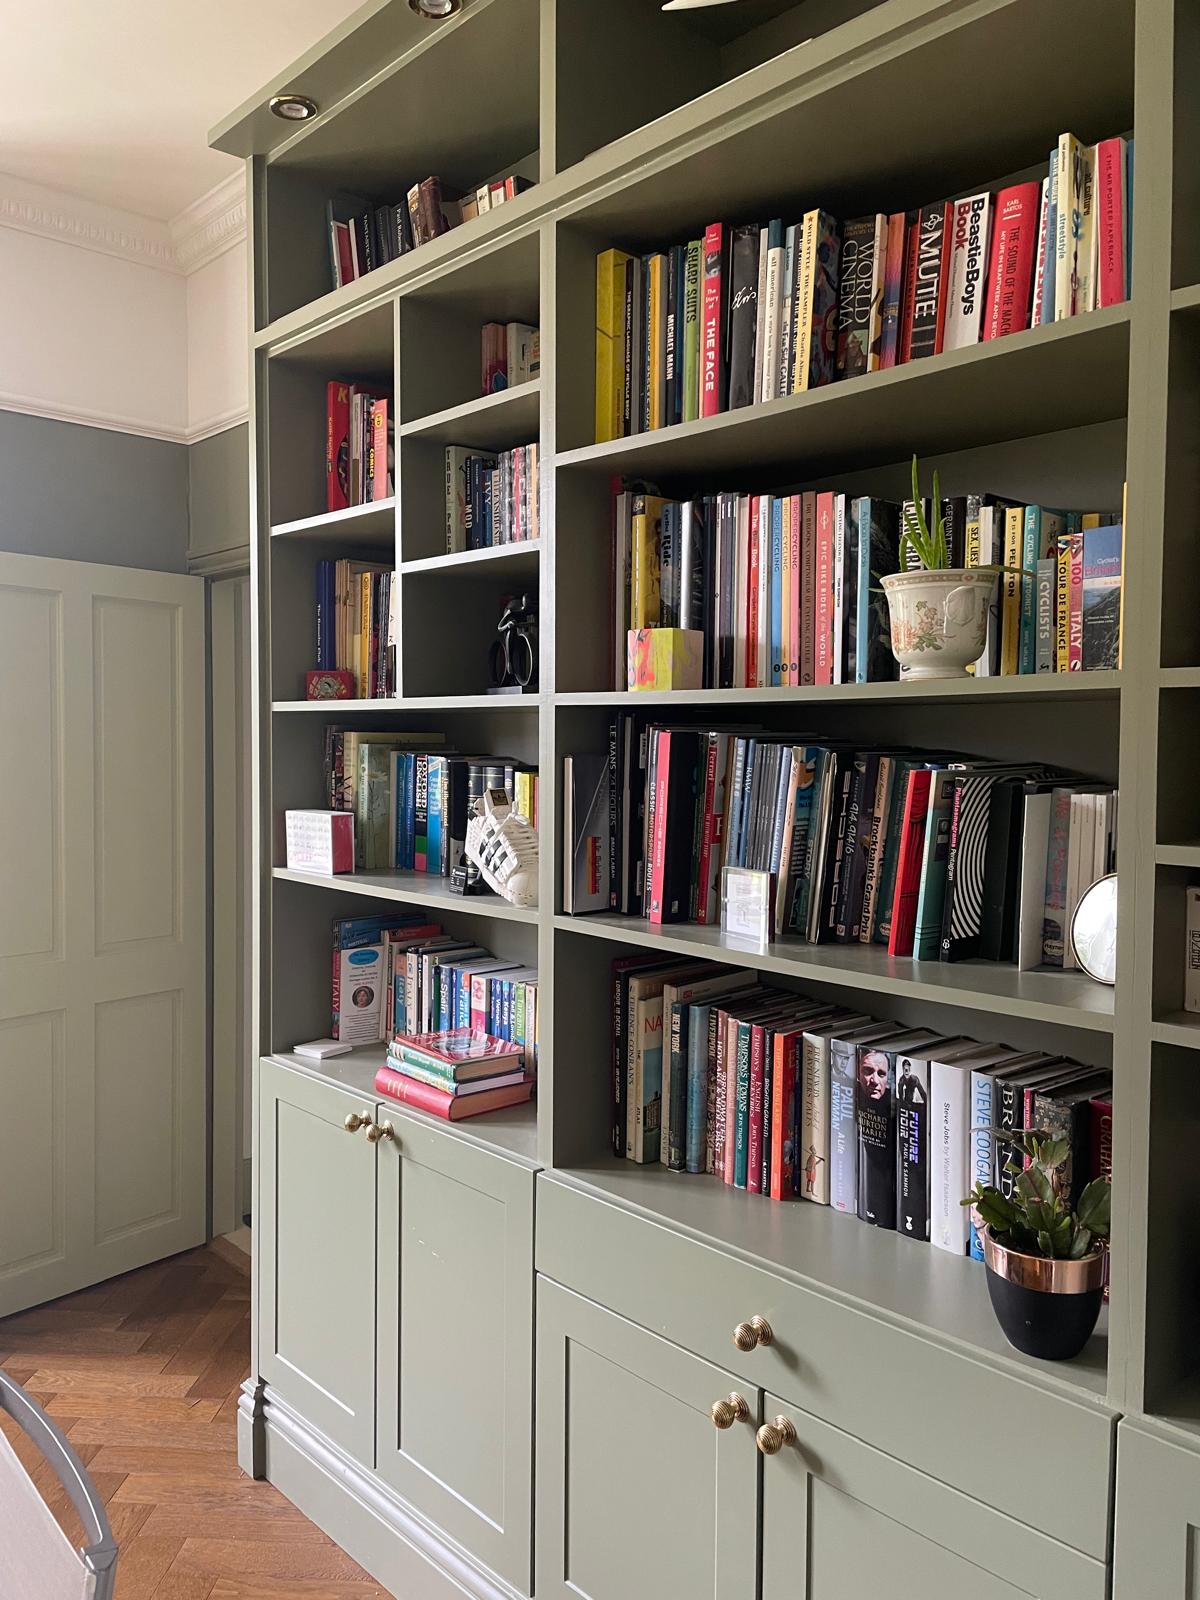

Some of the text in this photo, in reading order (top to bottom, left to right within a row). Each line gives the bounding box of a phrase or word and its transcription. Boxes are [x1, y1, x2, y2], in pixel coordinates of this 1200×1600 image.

[1106, 174, 1113, 185] MR
[955, 202, 970, 251] Book
[1000, 231, 1005, 240] MY
[1058, 213, 1067, 259] streetstyle
[998, 255, 1004, 263] IN
[1002, 226, 1020, 306] THE SOUND OF THE
[1106, 222, 1114, 273] PAPERBACK
[687, 247, 698, 323] SHARP SUITS
[769, 270, 777, 307] american
[839, 240, 856, 330] CINEMA
[855, 240, 874, 323] WORLD
[915, 229, 943, 319] MUTE
[994, 264, 1004, 304] KRAFTWERK
[993, 305, 1001, 319] AND
[666, 314, 674, 380] MICHAEL MANN
[705, 318, 716, 391] THE FACE
[464, 504, 472, 529] MOD
[945, 505, 953, 542] GERAINT
[662, 535, 672, 567] Ride
[969, 527, 979, 562] SEX, LIES
[1026, 534, 1034, 565] CYCLING
[1007, 549, 1016, 598] PELTON
[1039, 581, 1050, 639] CYCLISTS
[1058, 561, 1066, 650] TOUR DE FRANCE
[1070, 561, 1081, 648] 100 ITALY
[819, 634, 827, 667] WORLD
[609, 725, 617, 737] LE
[708, 750, 716, 782] Ferrari
[734, 747, 744, 798] WINNING
[828, 771, 851, 928] PORSCHE
[867, 816, 881, 881] Brockbank's
[948, 787, 962, 881] Phantasmagrams Pentagram
[805, 839, 813, 880] STORY
[864, 883, 873, 913] Grand
[861, 915, 870, 934] Prix
[332, 978, 340, 1010] ITALY
[396, 976, 405, 1006] Italy
[406, 975, 414, 1008] ITALY
[437, 983, 448, 1014] Spain
[644, 1016, 664, 1034] NA
[671, 1013, 680, 1053] NEW YORK
[708, 1014, 716, 1057] LIVERPOOL
[715, 1041, 723, 1085] HOYLAKE
[741, 1034, 749, 1078] TIMPSON'S
[740, 1081, 748, 1112] TOWNS
[832, 1080, 840, 1130] NEWMAN
[840, 1086, 853, 1121] PAUL
[943, 1102, 951, 1125] Steve
[909, 1110, 919, 1164] FUTURE
[943, 1126, 951, 1145] Jobs
[943, 1146, 950, 1156] by
[976, 1081, 991, 1187] STEVE COOGAN
[1001, 1089, 1013, 1200] BRND
